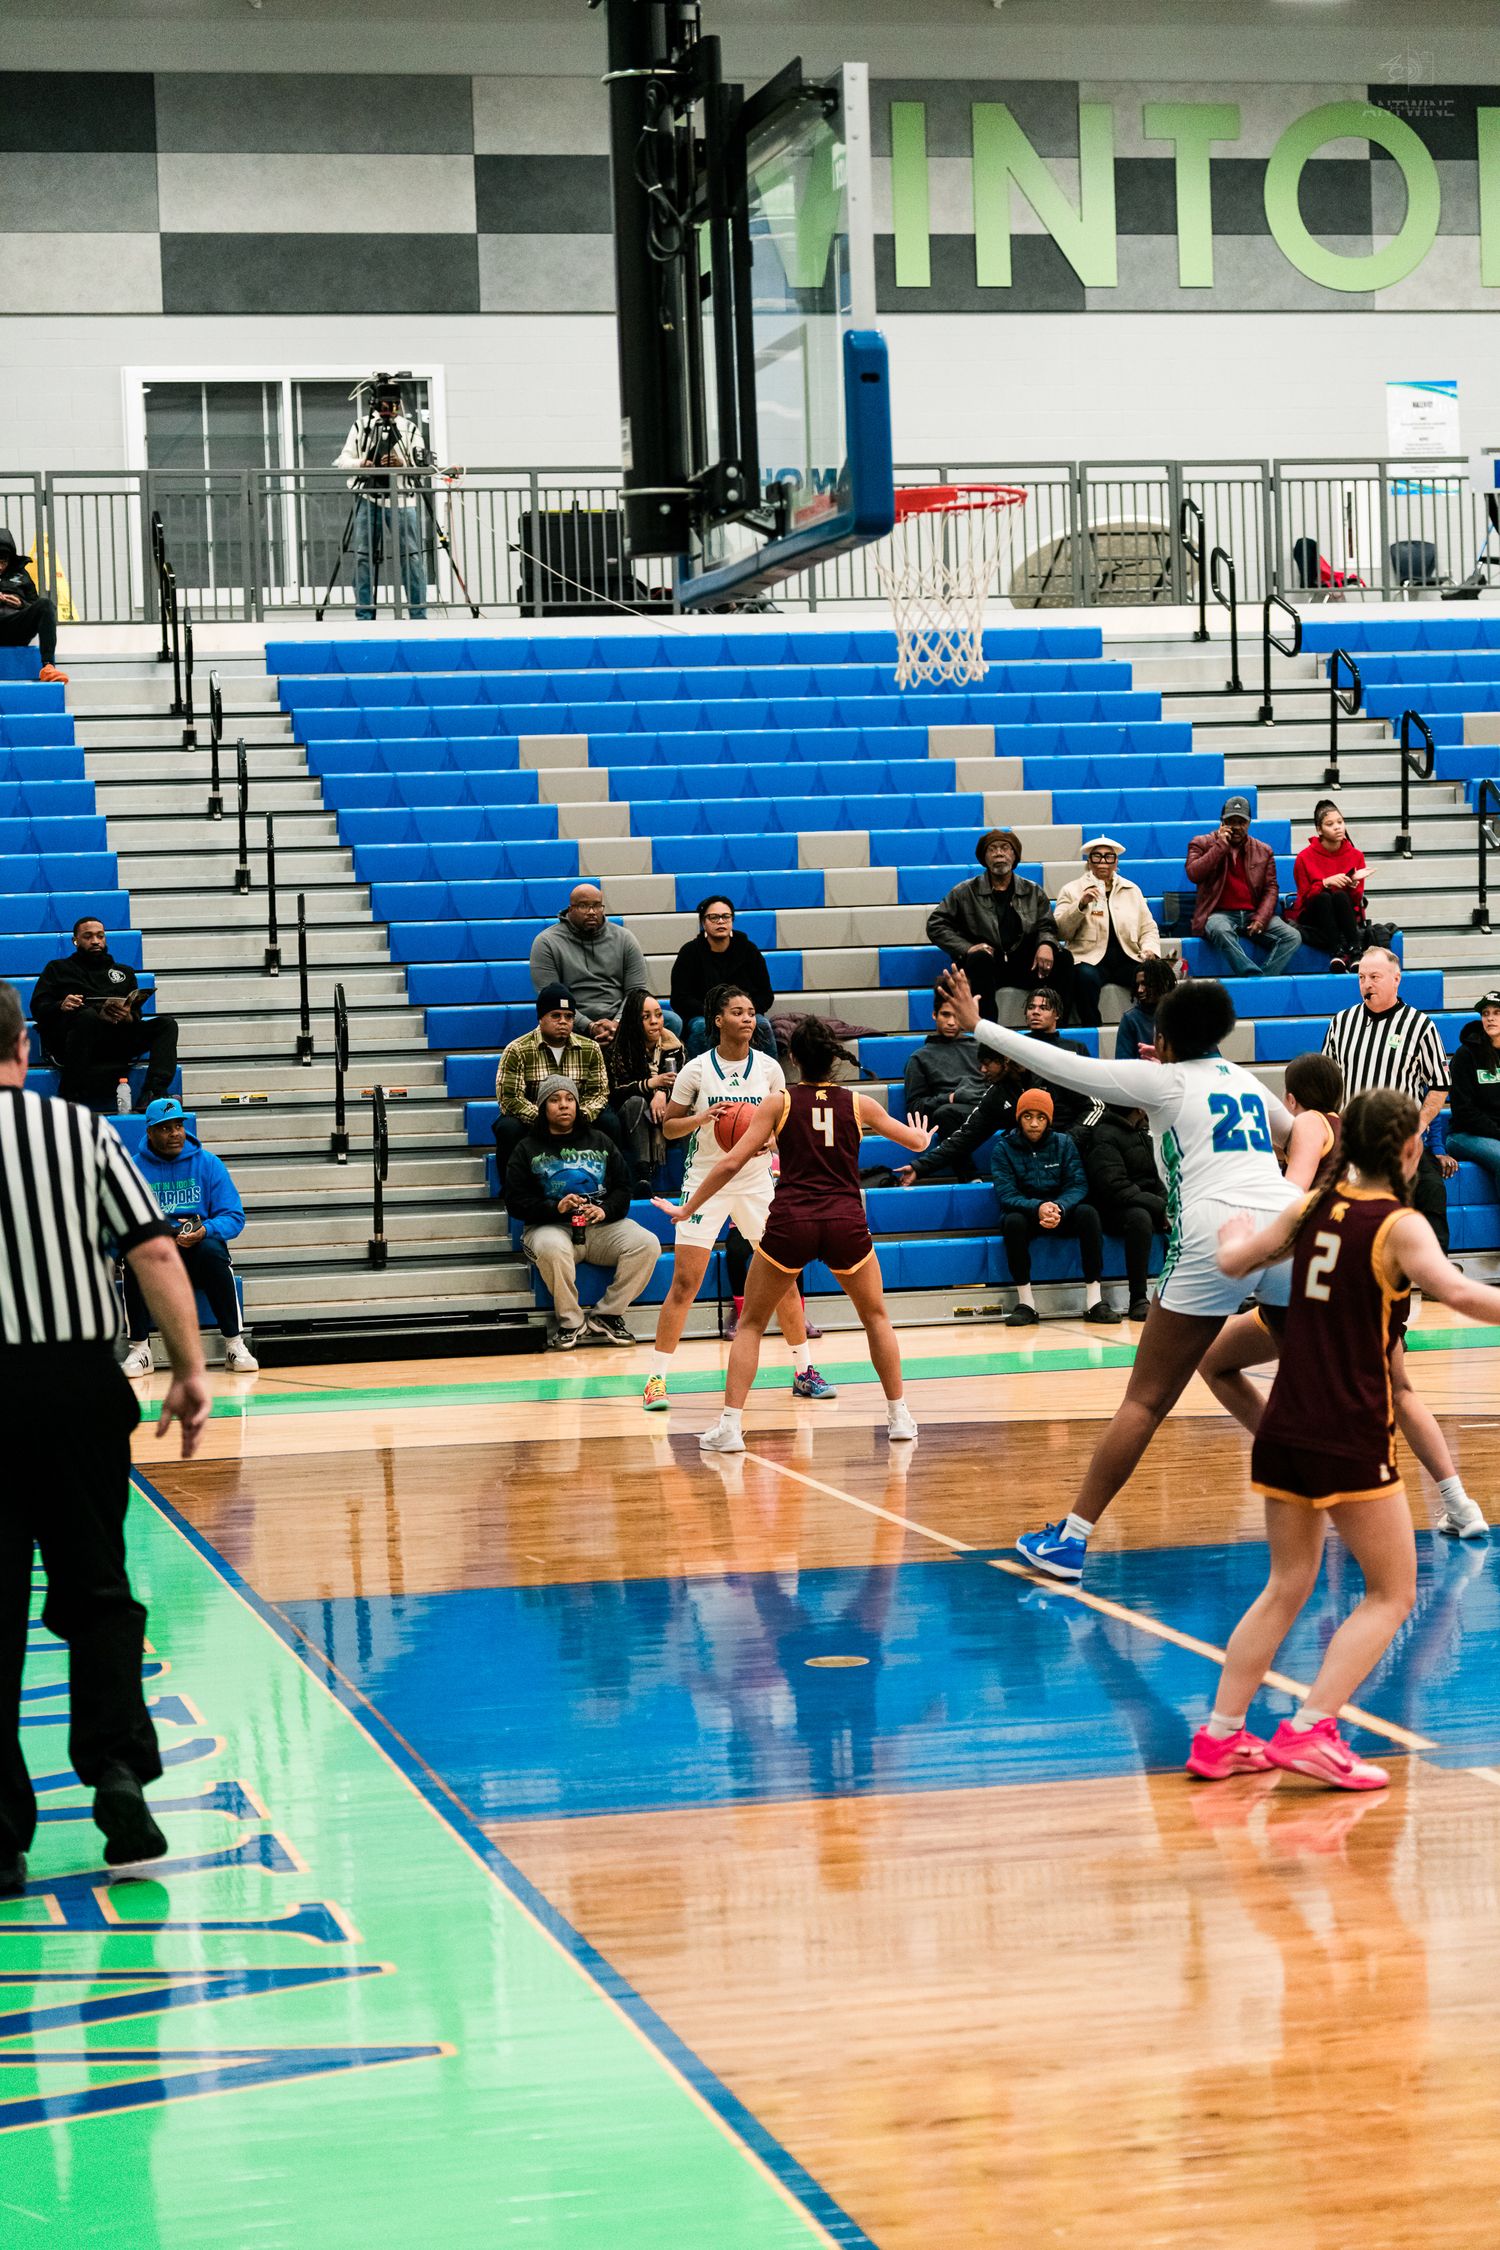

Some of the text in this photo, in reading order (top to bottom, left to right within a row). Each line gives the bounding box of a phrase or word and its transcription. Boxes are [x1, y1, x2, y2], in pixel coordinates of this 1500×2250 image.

[697, 100, 1500, 292] INTO
[811, 1107, 834, 1147] 4
[1207, 1093, 1274, 1153] 23
[1305, 1230, 1342, 1302] 2
